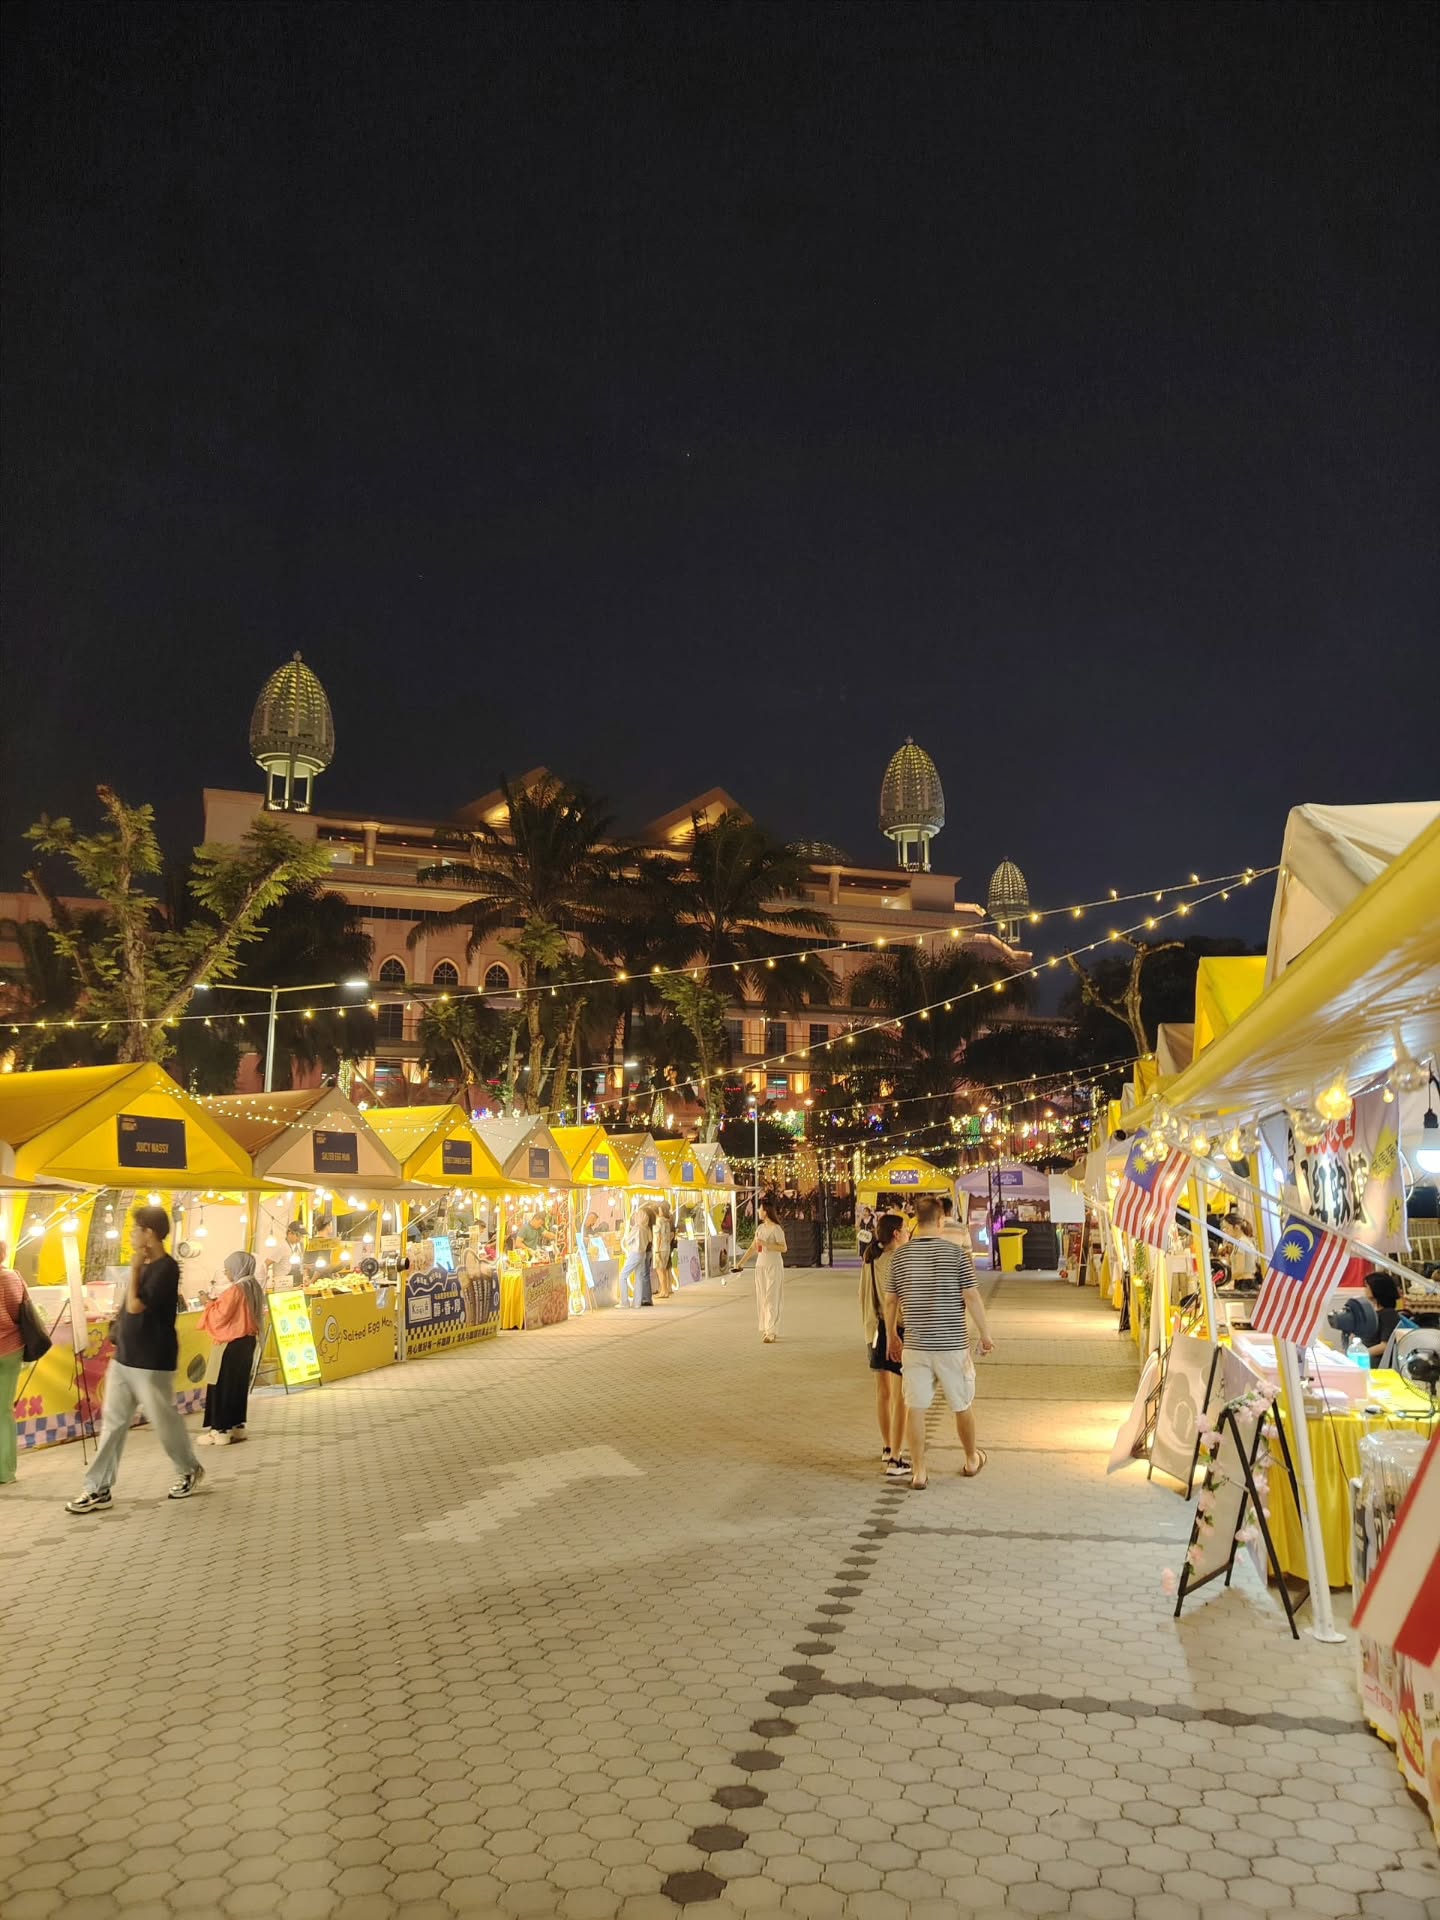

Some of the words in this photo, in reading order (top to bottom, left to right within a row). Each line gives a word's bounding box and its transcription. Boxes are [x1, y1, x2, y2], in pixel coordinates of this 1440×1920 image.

[342, 1328, 367, 1342] Salted
[367, 1322, 380, 1333] Egg
[381, 1316, 393, 1327] Man
